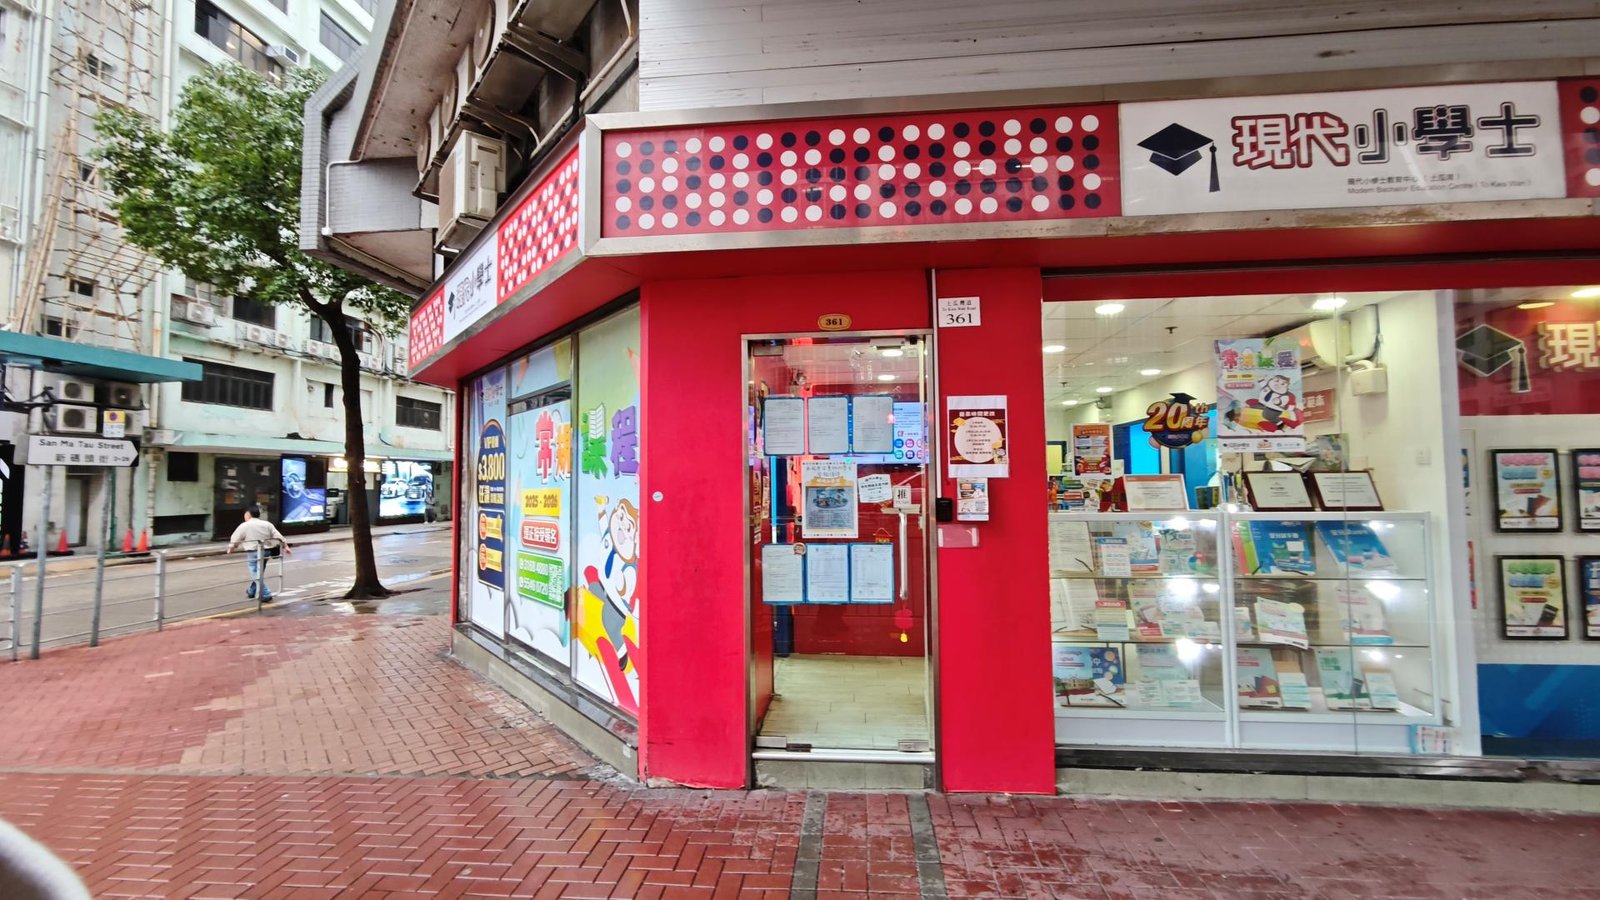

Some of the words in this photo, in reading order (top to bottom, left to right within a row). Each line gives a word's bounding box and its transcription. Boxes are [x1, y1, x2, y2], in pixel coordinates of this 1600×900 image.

[1230, 102, 1541, 170] 現代小學士
[1347, 186, 1375, 194] Modern
[1376, 185, 1408, 193] Bachelor
[826, 318, 843, 326] 361
[946, 313, 972, 325] 361
[1547, 322, 1600, 368] 現
[39, 438, 57, 446] San
[60, 440, 74, 448] Ma
[78, 440, 94, 449] Tau
[97, 442, 124, 450] Street
[478, 452, 505, 481] $3,800
[897, 489, 906, 499] 推
